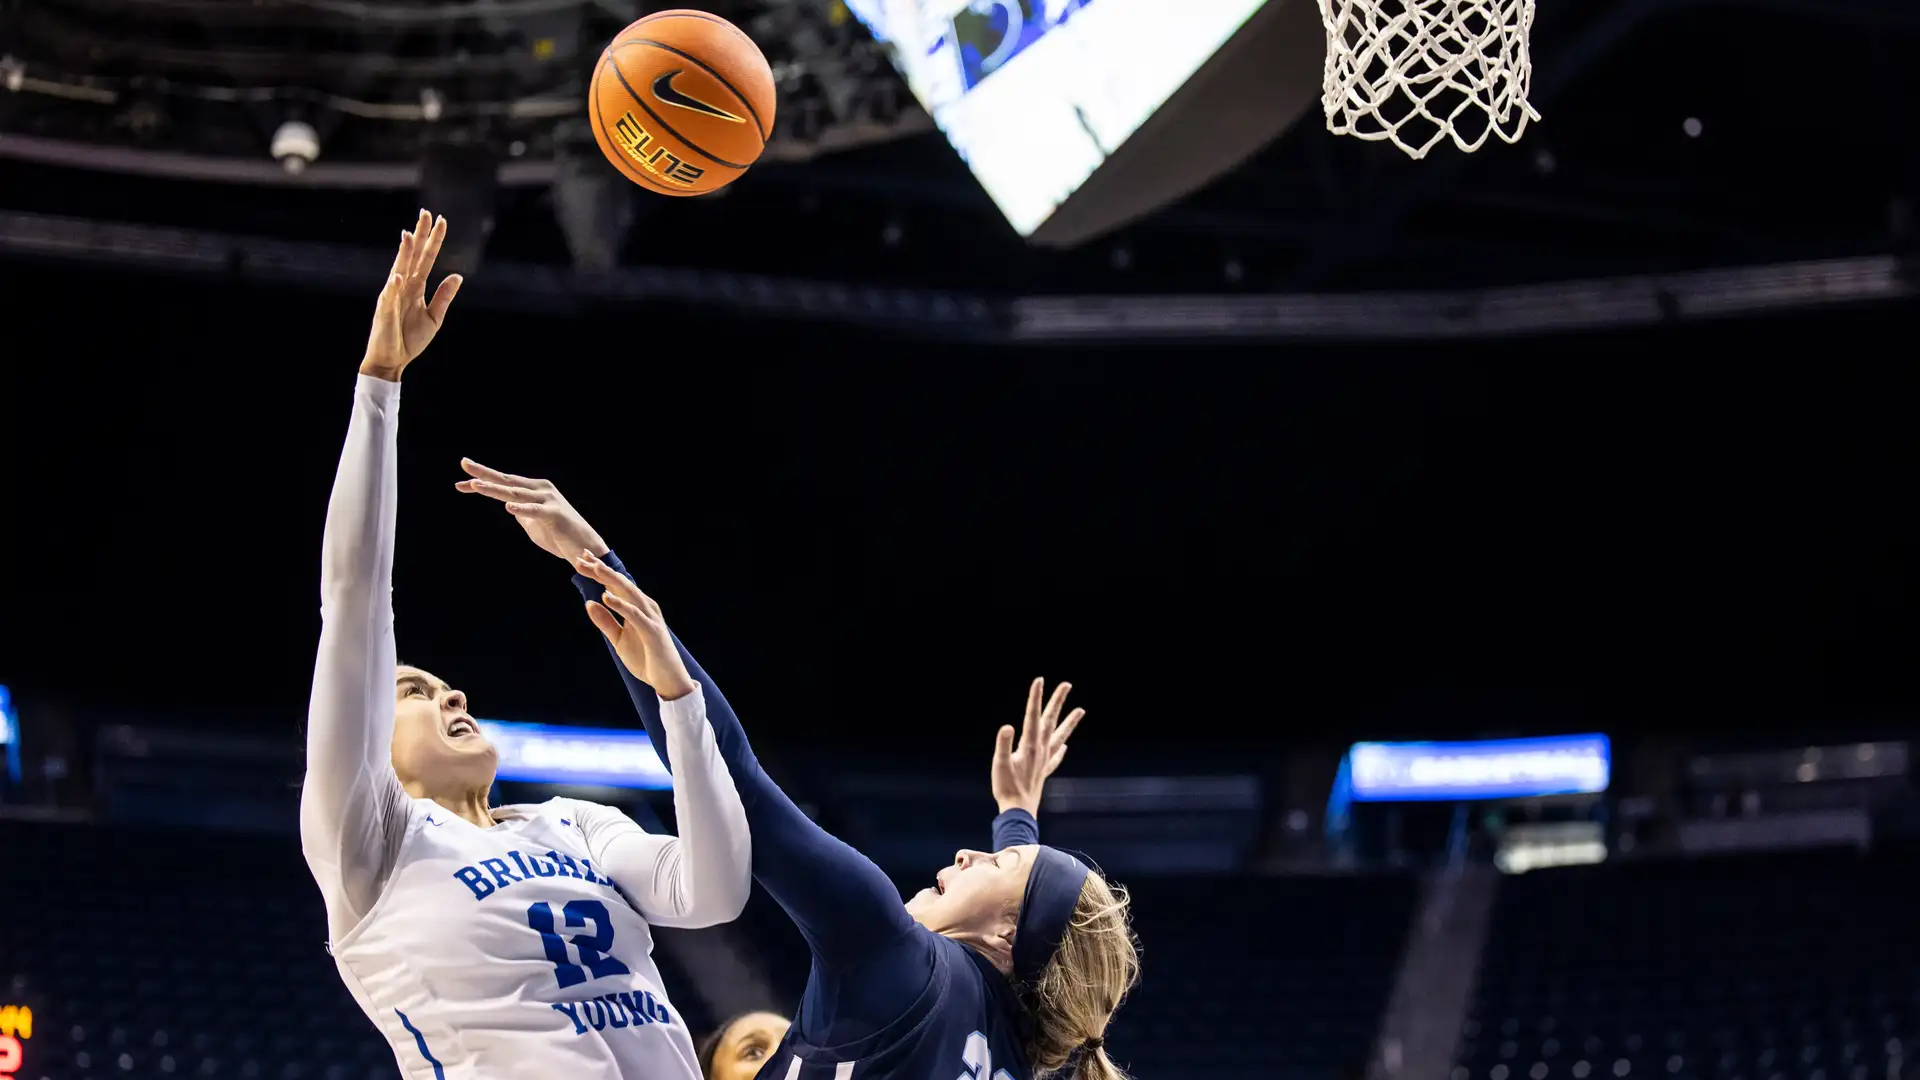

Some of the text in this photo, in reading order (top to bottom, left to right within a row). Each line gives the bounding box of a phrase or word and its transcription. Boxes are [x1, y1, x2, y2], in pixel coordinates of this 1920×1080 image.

[614, 110, 706, 185] ELITE
[452, 850, 623, 902] BRIGHA
[527, 900, 631, 989] 12
[551, 990, 670, 1035] YOUNG
